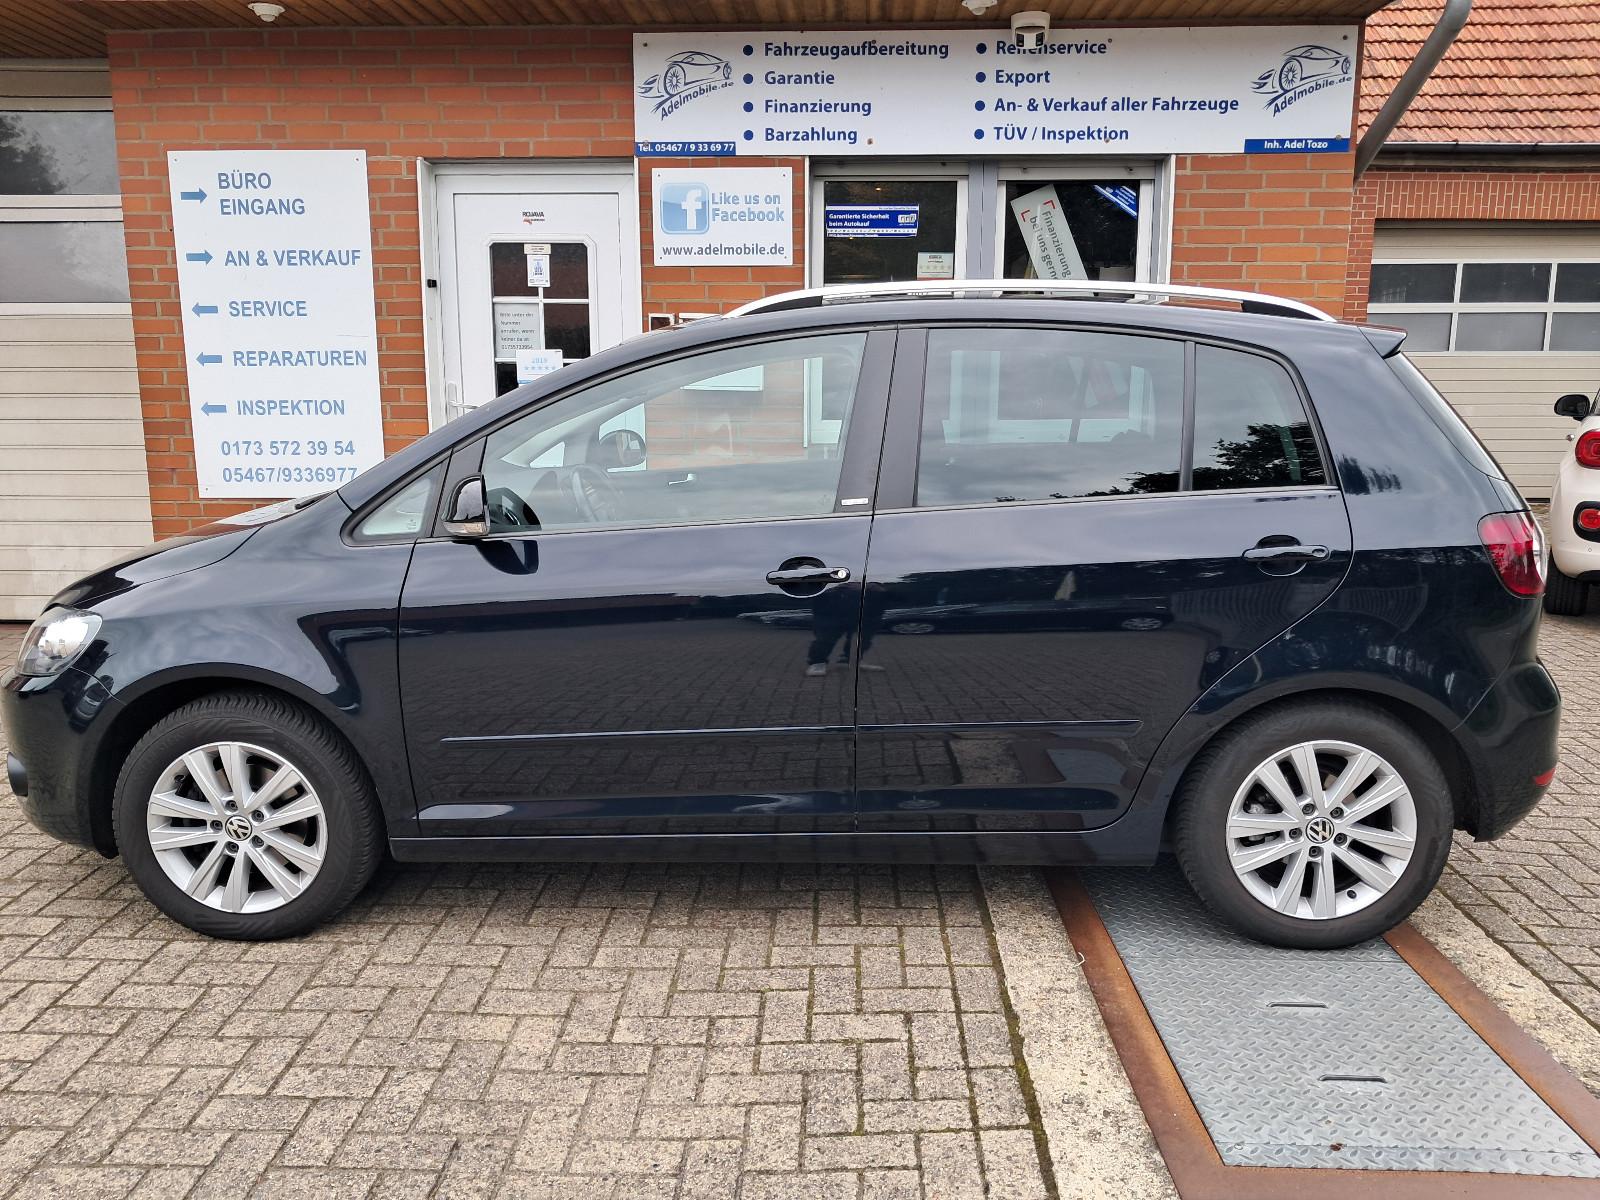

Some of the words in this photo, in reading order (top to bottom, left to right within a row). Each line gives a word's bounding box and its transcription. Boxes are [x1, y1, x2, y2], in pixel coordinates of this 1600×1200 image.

[764, 41, 950, 59] Fahrzeugaufbereitung
[764, 70, 835, 85] Garantie
[994, 70, 1051, 86] Export
[660, 81, 735, 121] Adelmobile.de
[993, 97, 1023, 112] An-
[1026, 97, 1039, 112] &
[1043, 96, 1108, 112] Verkauf
[1110, 96, 1148, 111] aller
[1152, 97, 1239, 114] Fahrzeuge
[1272, 76, 1353, 118] Adelmobile.de
[764, 99, 872, 116] Finanzierung
[764, 128, 858, 145] Barzahlung
[993, 123, 1028, 141] TÜV
[1041, 126, 1129, 143] Inspektion
[637, 143, 653, 152] Tel.
[655, 143, 682, 152] 05467
[690, 143, 695, 152] 9
[697, 143, 708, 152] 33
[710, 143, 721, 152] 69
[723, 143, 735, 152] 77
[1264, 140, 1281, 149] Inh.
[1283, 140, 1305, 149] Adel
[1306, 140, 1328, 149] Tozo
[217, 169, 272, 190] BÜRO
[219, 198, 306, 215] EINGANG
[711, 192, 739, 205] Like
[744, 194, 760, 205] us
[764, 194, 781, 205] on
[711, 207, 785, 222] Facebook
[662, 243, 785, 255] www.adelmobile.de
[1037, 234, 1048, 253] uns
[1042, 210, 1072, 278] Finanzierung
[224, 250, 250, 266] AN
[255, 250, 269, 266] &
[273, 249, 361, 266] VERKAUF
[228, 300, 308, 317] SERVICE
[232, 350, 367, 367] REPARATUREN
[237, 399, 345, 416] INSPEKTION
[221, 440, 263, 456] 0173
[269, 440, 301, 456] 572
[307, 440, 328, 456] 39
[334, 440, 355, 456] 54
[222, 467, 358, 483] 05467/9336977
